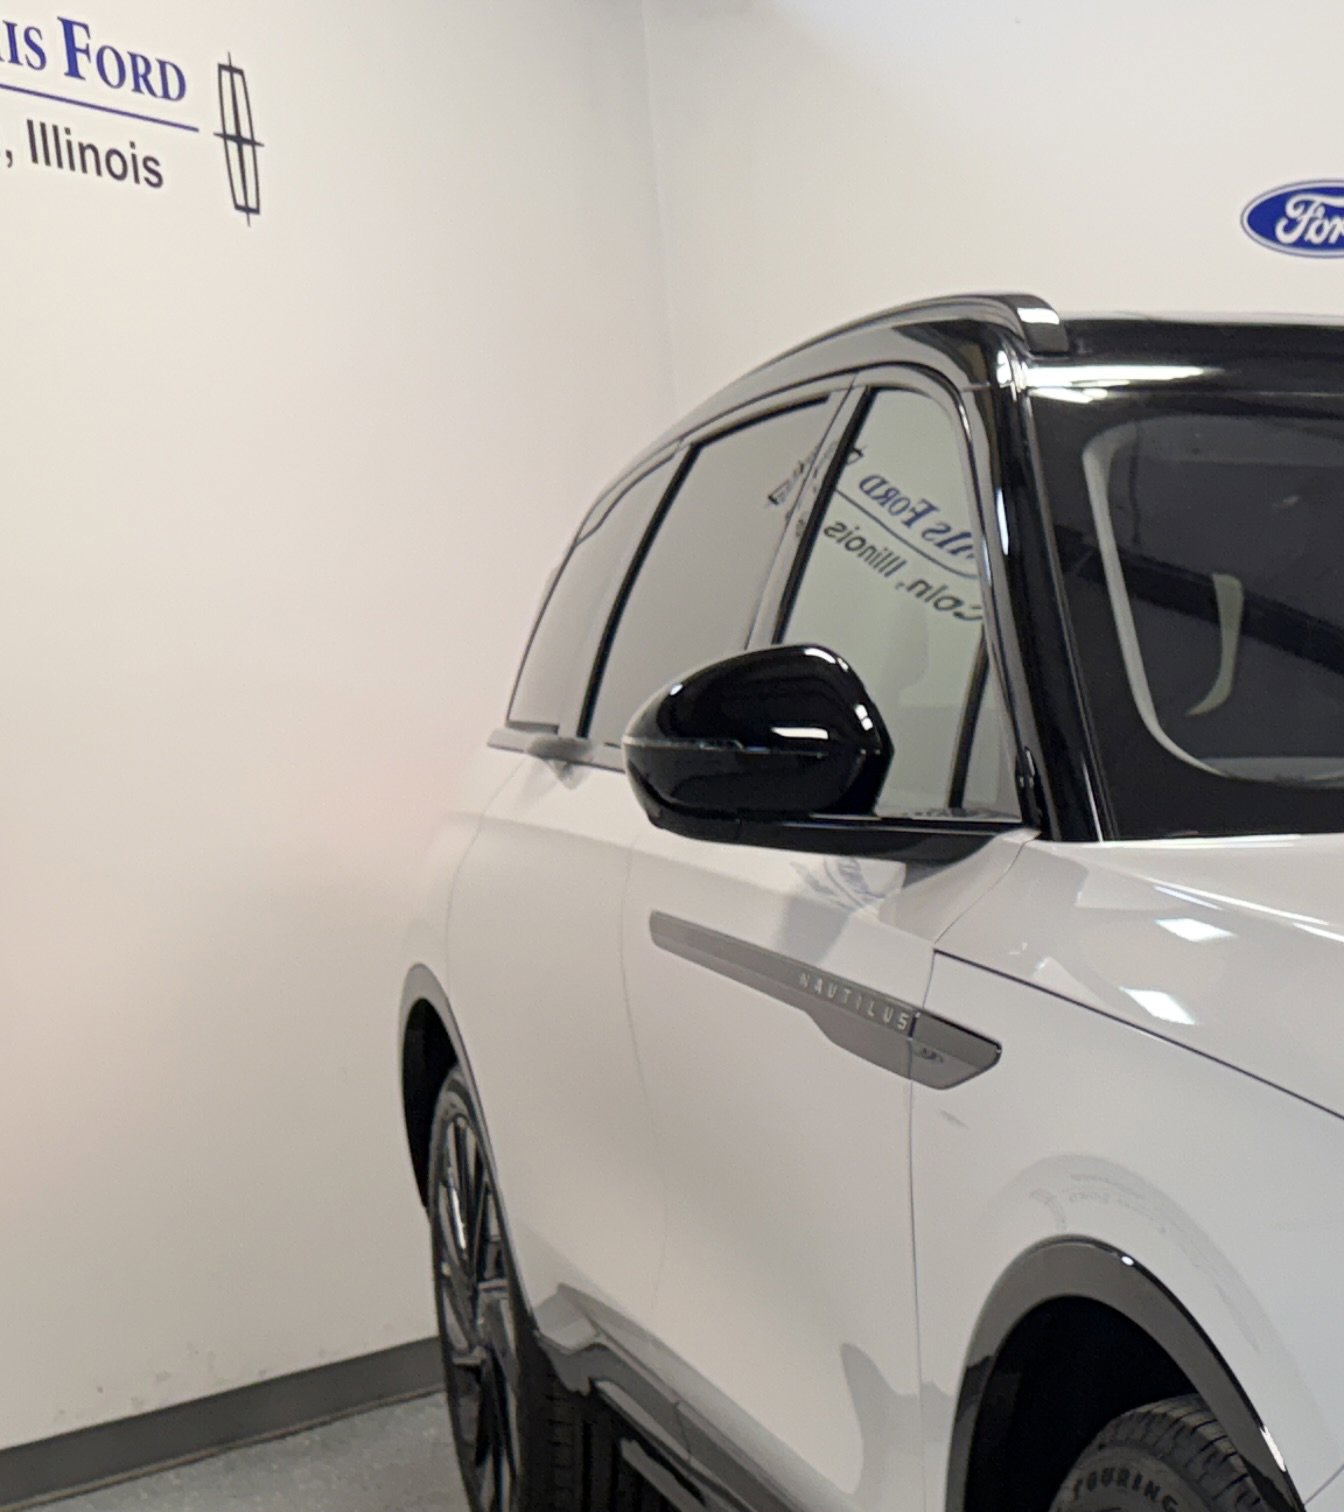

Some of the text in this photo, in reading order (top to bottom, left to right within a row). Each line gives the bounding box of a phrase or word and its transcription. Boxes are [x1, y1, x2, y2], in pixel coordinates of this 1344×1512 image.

[0, 15, 188, 103] IS FORD
[26, 118, 164, 190] Illinois
[799, 971, 910, 1031] NAUTILUS
